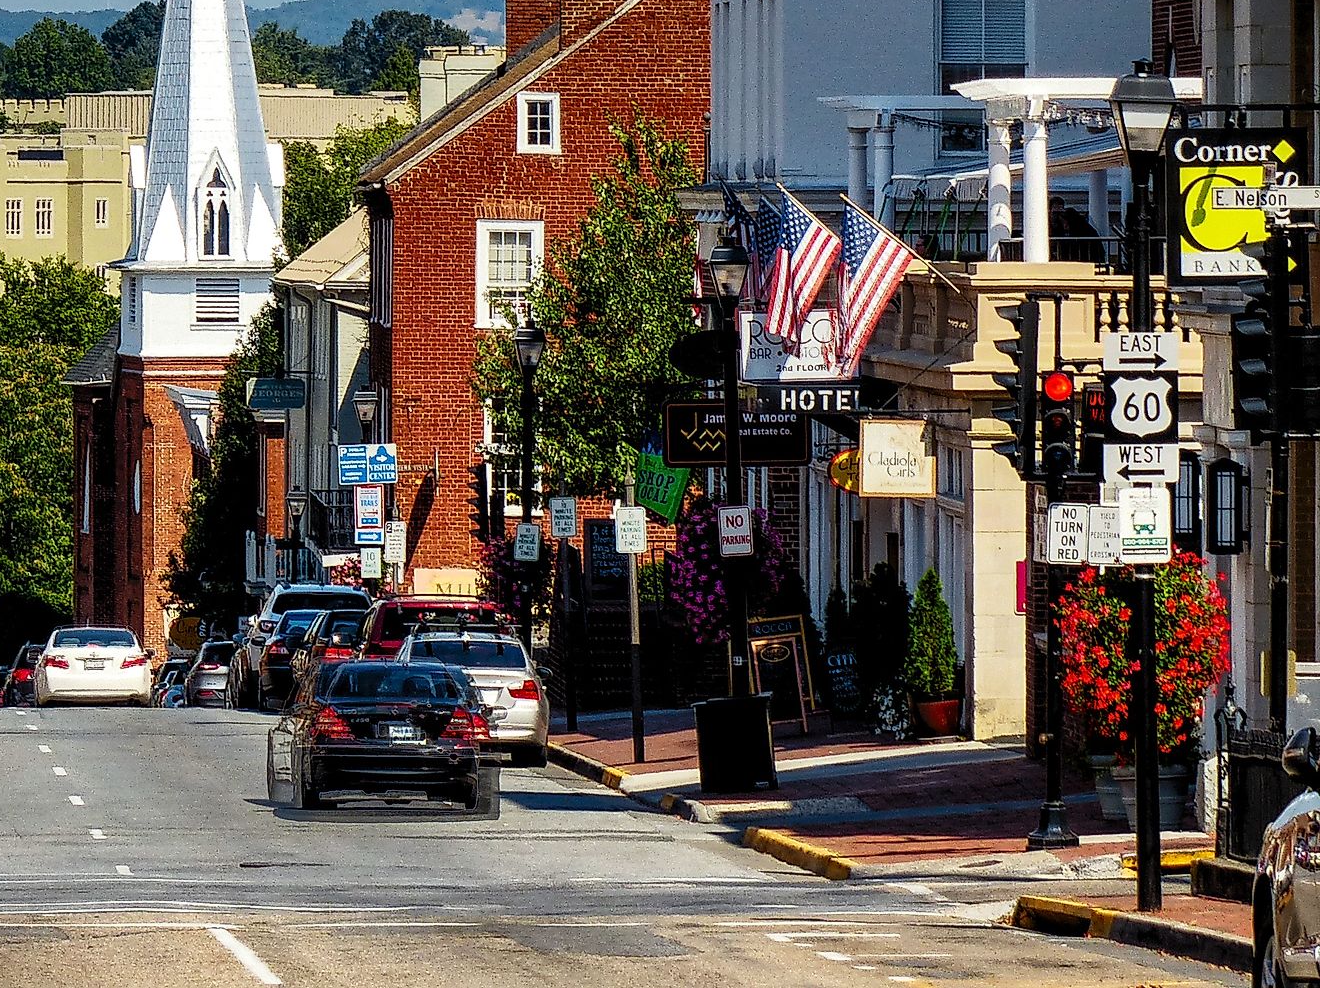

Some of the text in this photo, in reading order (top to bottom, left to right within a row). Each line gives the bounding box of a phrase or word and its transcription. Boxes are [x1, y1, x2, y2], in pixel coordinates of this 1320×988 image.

[1174, 137, 1272, 163] Corner
[1216, 190, 1229, 206] E.
[1235, 190, 1287, 206] Nelson
[1194, 259, 1257, 273] BANK
[1120, 335, 1162, 352] EAST
[749, 347, 772, 360] BAR
[797, 364, 827, 372] FLOOR
[1123, 392, 1161, 422] 60
[703, 413, 726, 424] Jam
[739, 428, 751, 436] eal
[752, 428, 778, 436] Estate
[1119, 445, 1163, 463] WEST
[369, 464, 395, 472] VISITOR
[369, 473, 395, 481] CENTER
[637, 468, 676, 489] SHOP
[639, 485, 668, 505] OCAL
[1062, 508, 1077, 519] NO
[725, 515, 744, 528] NO
[1055, 522, 1083, 533] TURN
[721, 534, 751, 546] PARKING
[1061, 536, 1076, 546] ON
[1090, 531, 1120, 539] PEDESTRIAN
[1057, 549, 1079, 560] RED
